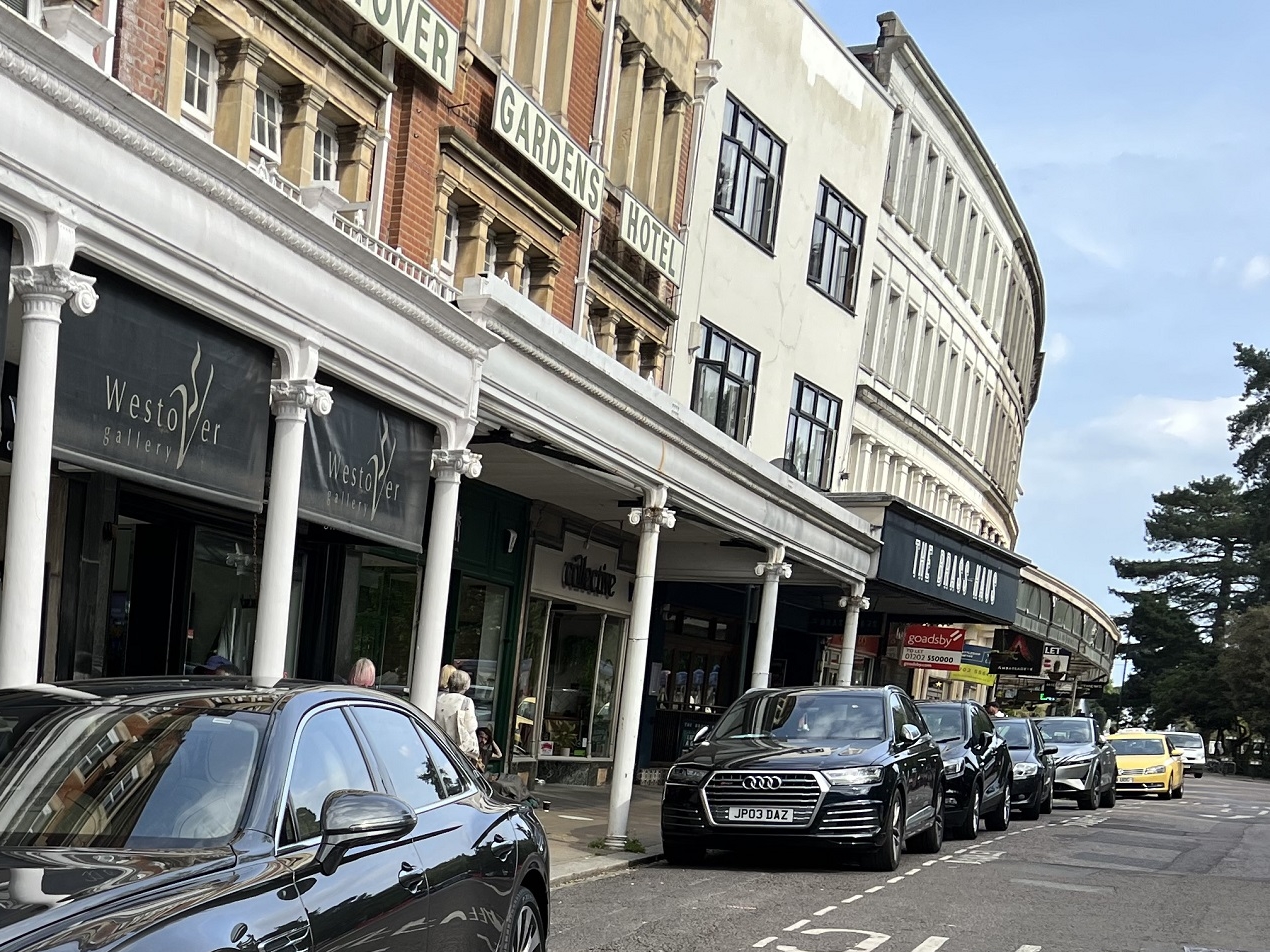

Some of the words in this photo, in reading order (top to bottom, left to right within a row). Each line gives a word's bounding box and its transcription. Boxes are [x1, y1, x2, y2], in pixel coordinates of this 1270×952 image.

[499, 86, 600, 210] GARDENS
[626, 201, 677, 278] HOTEL
[103, 426, 172, 463] gallery
[327, 490, 369, 516] gallery
[912, 538, 934, 583] THE
[936, 549, 970, 596] BRASS
[972, 564, 998, 606] HAUS
[907, 634, 953, 648] goadsby
[1044, 646, 1060, 655] LET
[905, 653, 926, 661] 01202
[927, 655, 954, 663] 550000
[734, 808, 763, 819] JP03
[765, 809, 789, 820] DAZ
